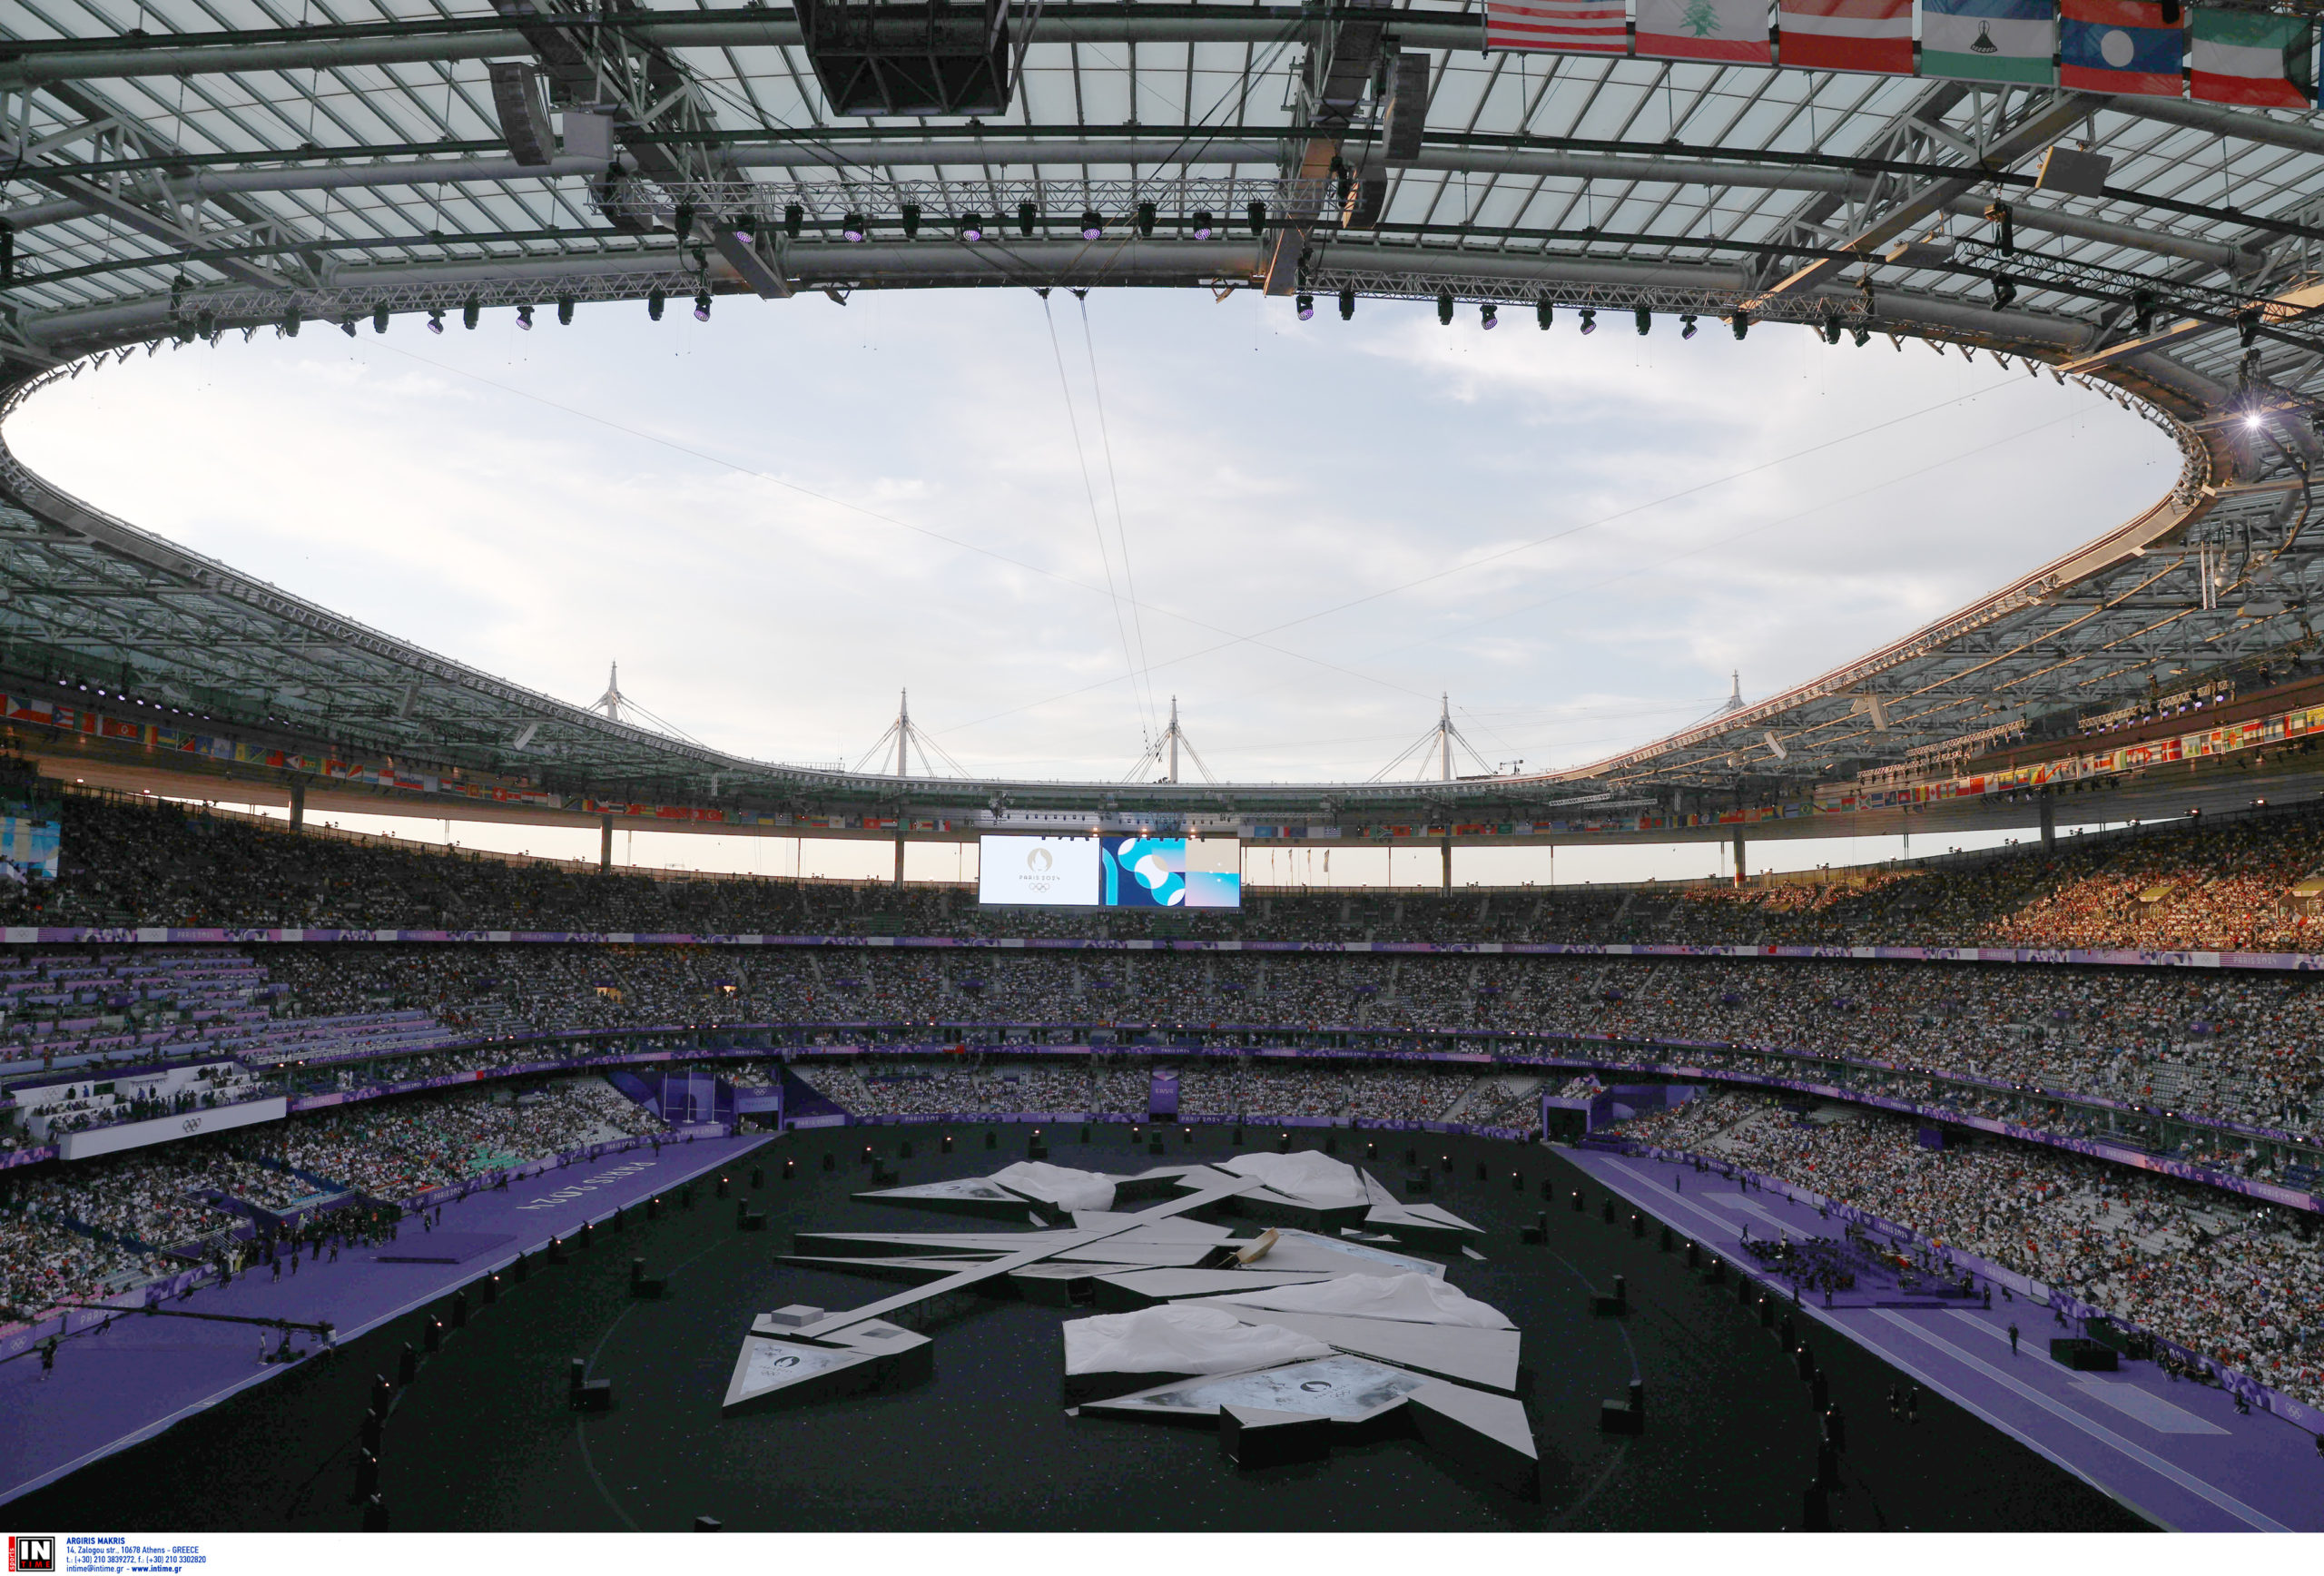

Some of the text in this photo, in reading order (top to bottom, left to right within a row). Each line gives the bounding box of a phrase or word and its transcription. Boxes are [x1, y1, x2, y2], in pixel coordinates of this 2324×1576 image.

[2257, 957, 2278, 965] 2024
[434, 1187, 463, 1200] PARIS 2024
[515, 1162, 657, 1209] PARIS 2024
[2258, 1187, 2299, 1204] PARIS 2024
[1878, 1222, 1908, 1240] PARIS 2024
